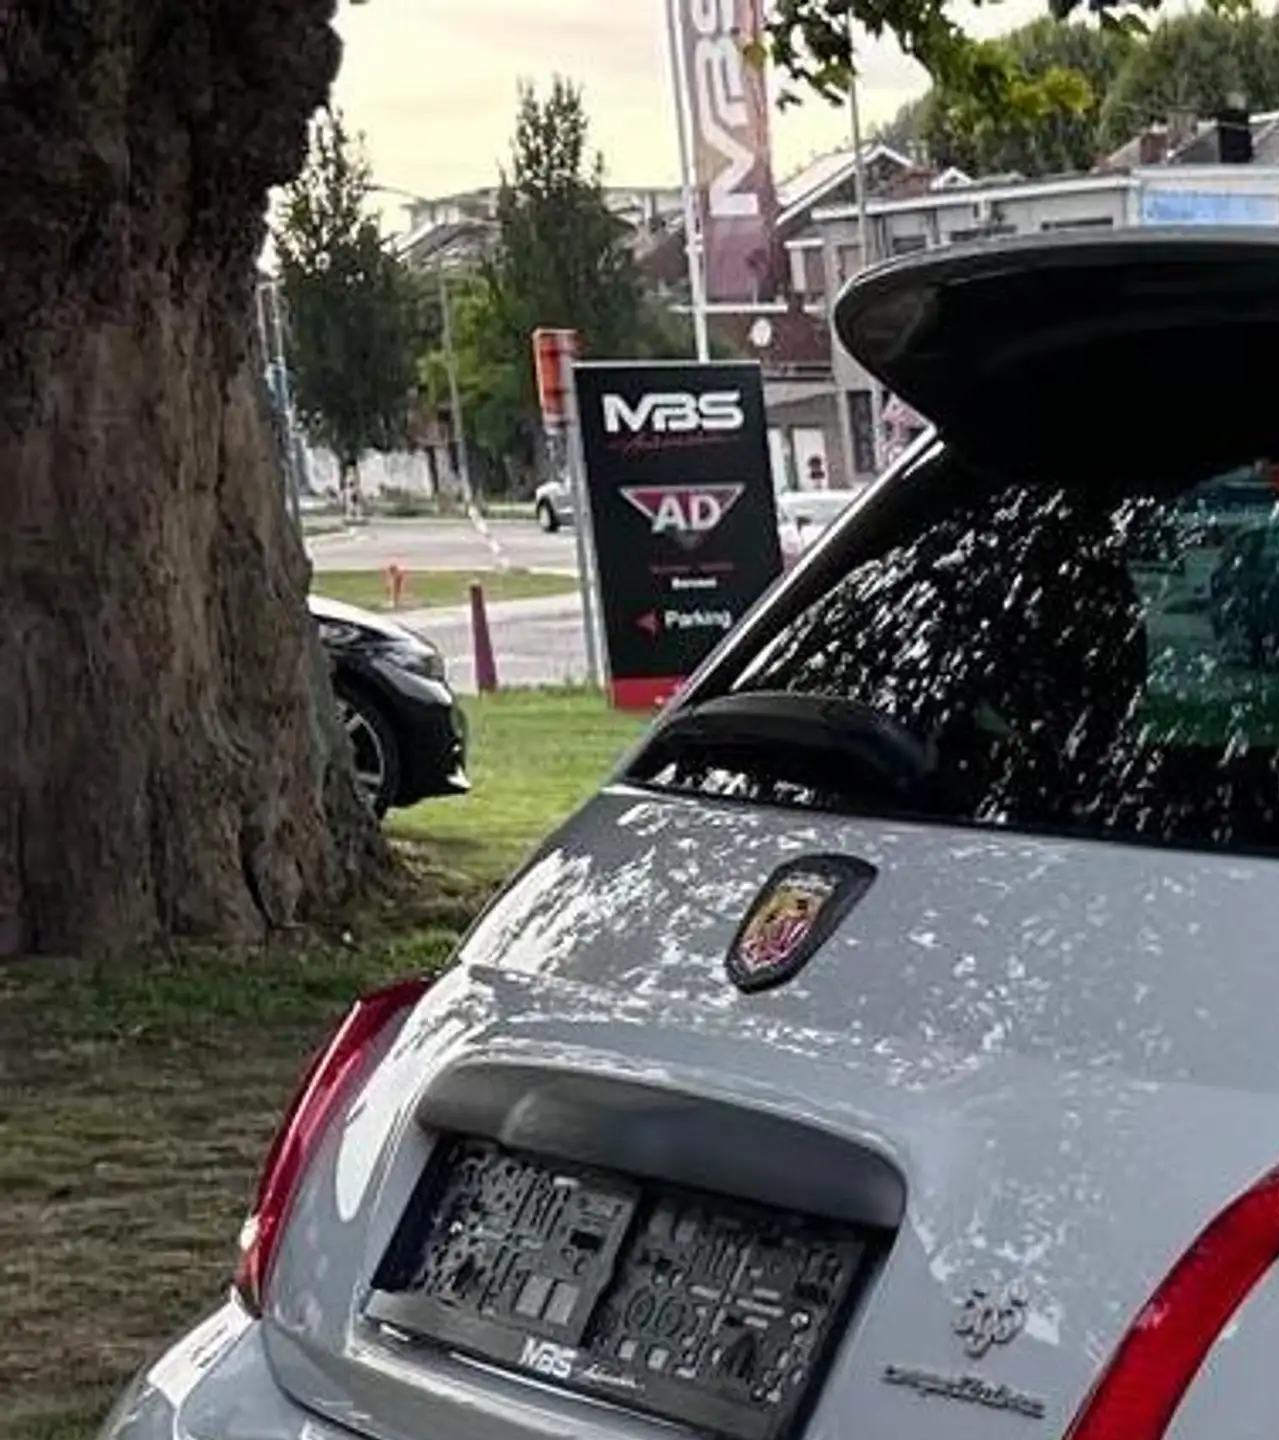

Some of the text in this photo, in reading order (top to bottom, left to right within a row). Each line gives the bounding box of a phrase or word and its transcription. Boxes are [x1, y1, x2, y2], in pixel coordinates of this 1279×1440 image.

[602, 389, 744, 433] MBS
[652, 493, 721, 534] AD
[664, 608, 732, 630] Parking
